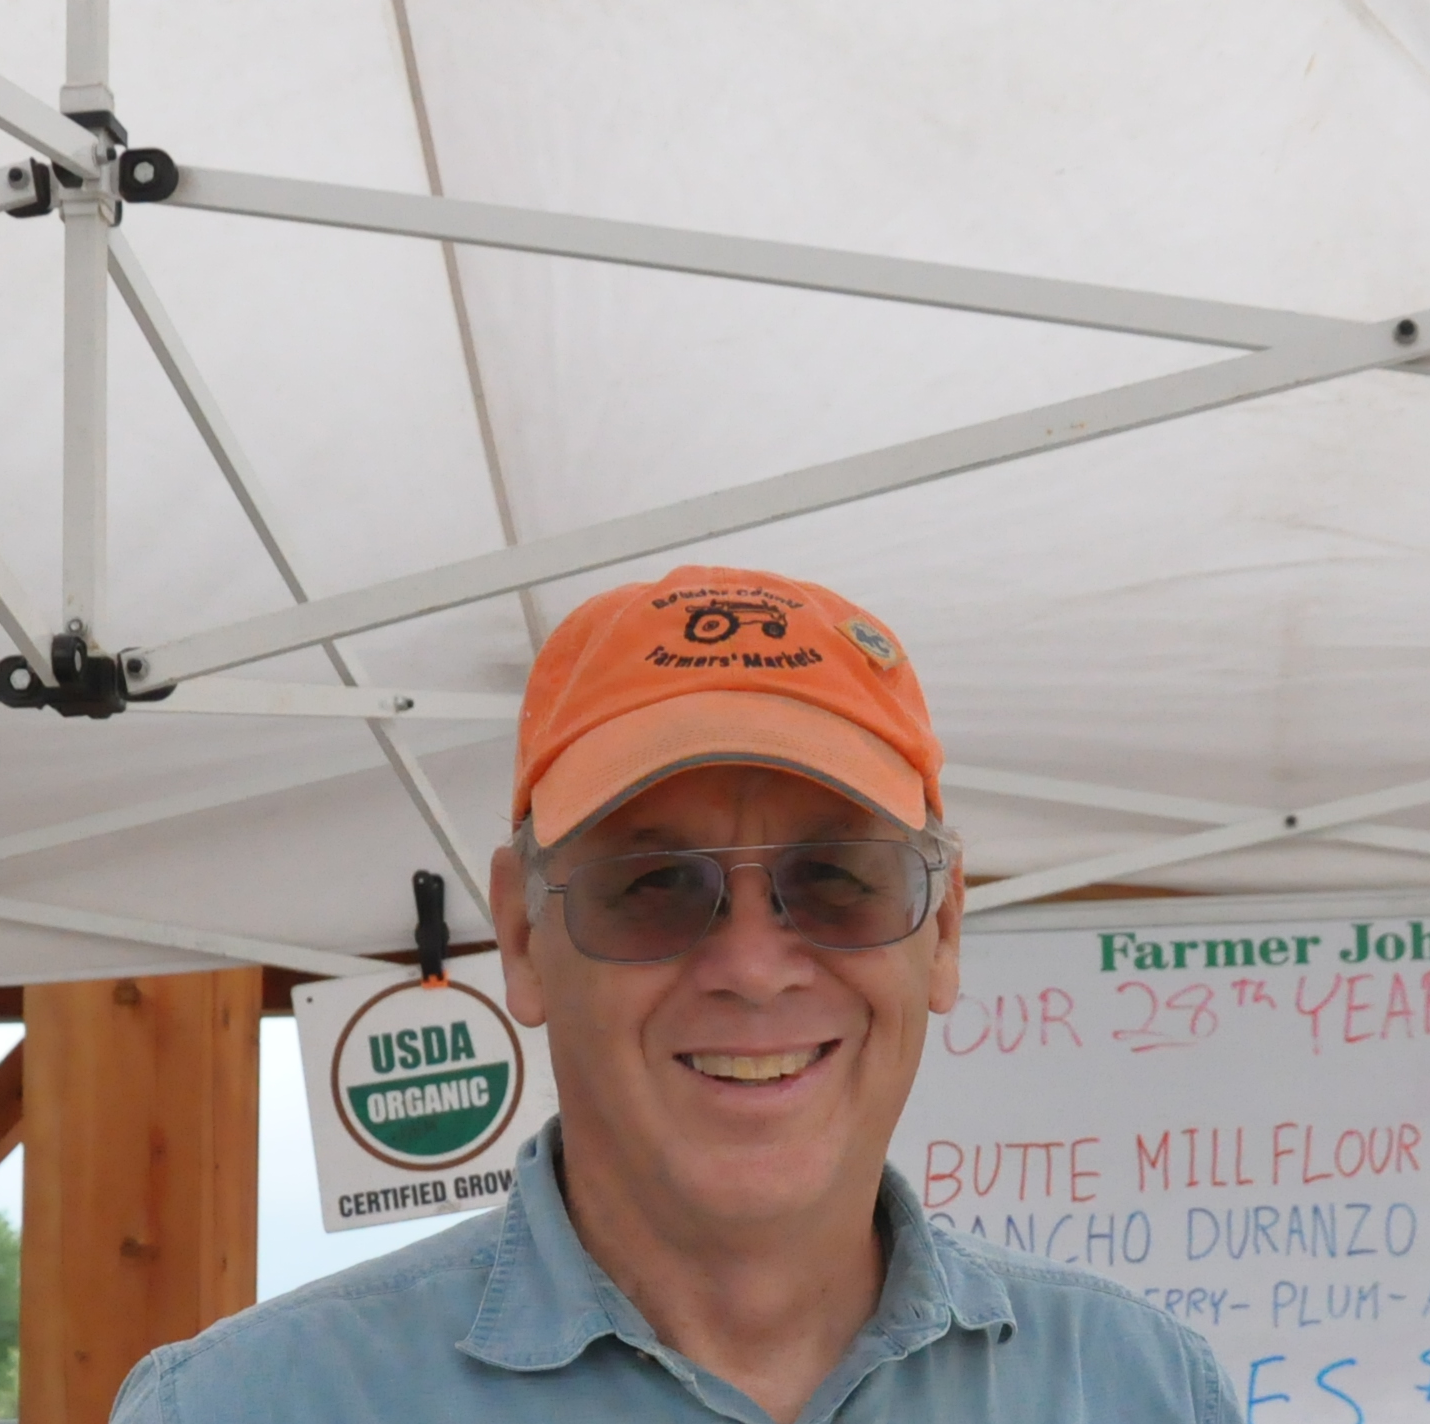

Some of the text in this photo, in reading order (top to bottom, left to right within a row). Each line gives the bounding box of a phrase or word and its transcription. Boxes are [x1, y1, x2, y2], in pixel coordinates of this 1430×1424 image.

[742, 646, 824, 669] Markets
[1096, 930, 1321, 973] Farmer
[368, 1020, 477, 1075] USDA
[943, 986, 1084, 1057] OUR
[367, 1075, 490, 1125] ORGANIC
[923, 1136, 1102, 1210] BUTTE
[1135, 1126, 1254, 1193] MILL
[1272, 1120, 1422, 1186] FLOUR
[339, 1180, 447, 1218] CERTIFIED
[1186, 1202, 1418, 1261] DURANZO
